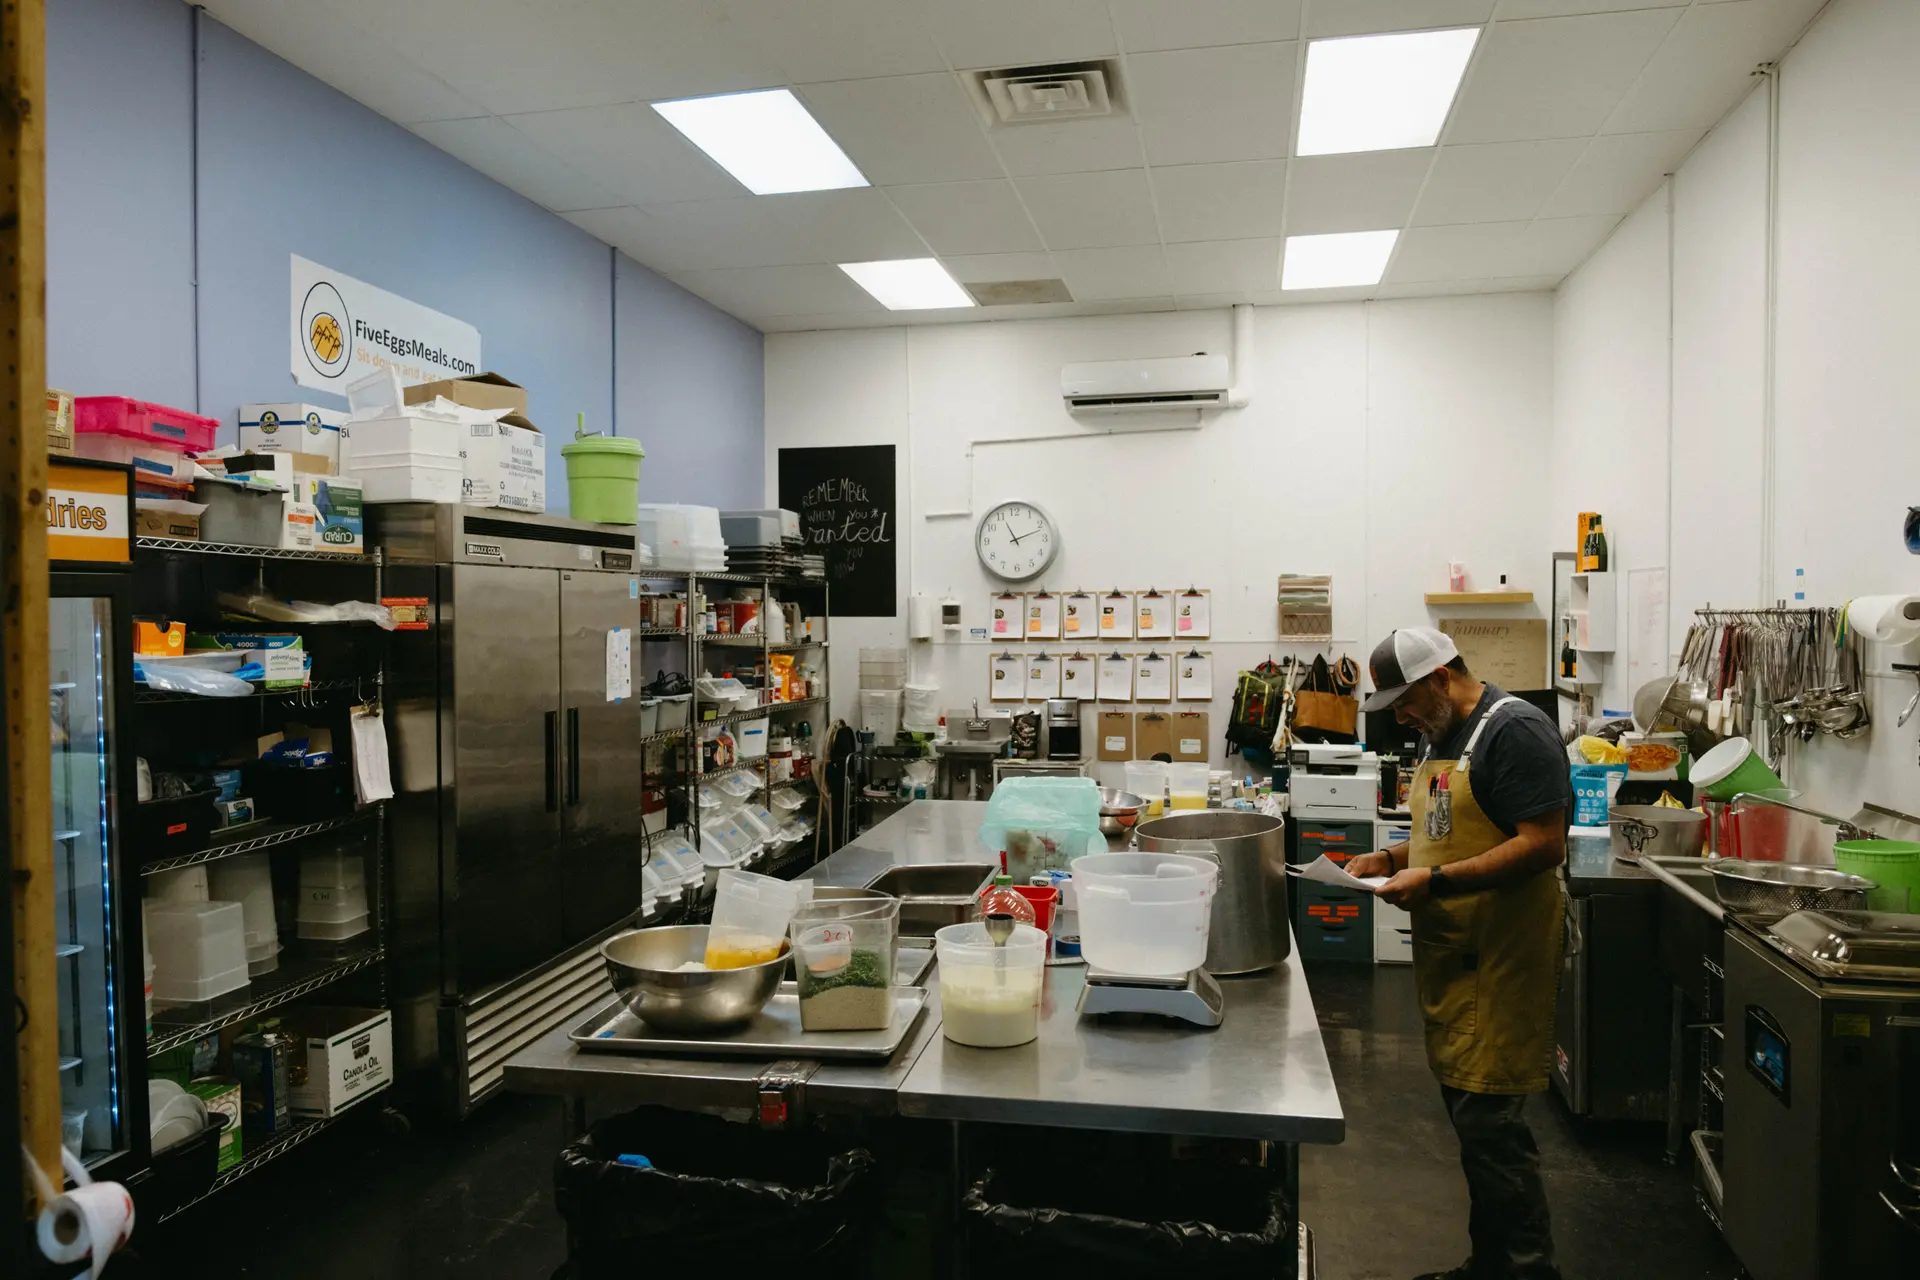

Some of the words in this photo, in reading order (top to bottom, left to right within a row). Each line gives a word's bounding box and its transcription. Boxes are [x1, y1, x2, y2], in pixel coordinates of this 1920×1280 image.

[356, 319, 475, 375] FiveEggsMeals.com
[357, 347, 370, 364] Sit
[403, 365, 420, 379] and
[803, 477, 869, 508] REMEMBER
[807, 509, 835, 522] WHEN
[997, 512, 1004, 521] 11
[1009, 507, 1020, 517] 12
[1027, 509, 1032, 519] 1
[987, 523, 997, 532] 10
[1037, 520, 1043, 529] 2
[324, 531, 353, 543] CURAD
[984, 537, 990, 546] 9
[1042, 533, 1048, 543] 3
[989, 552, 996, 560] 8
[1038, 548, 1044, 557] 4
[1001, 561, 1006, 570] 7
[1029, 559, 1035, 568] 5
[1014, 564, 1020, 573] 6
[343, 1063, 367, 1081] CANOLA
